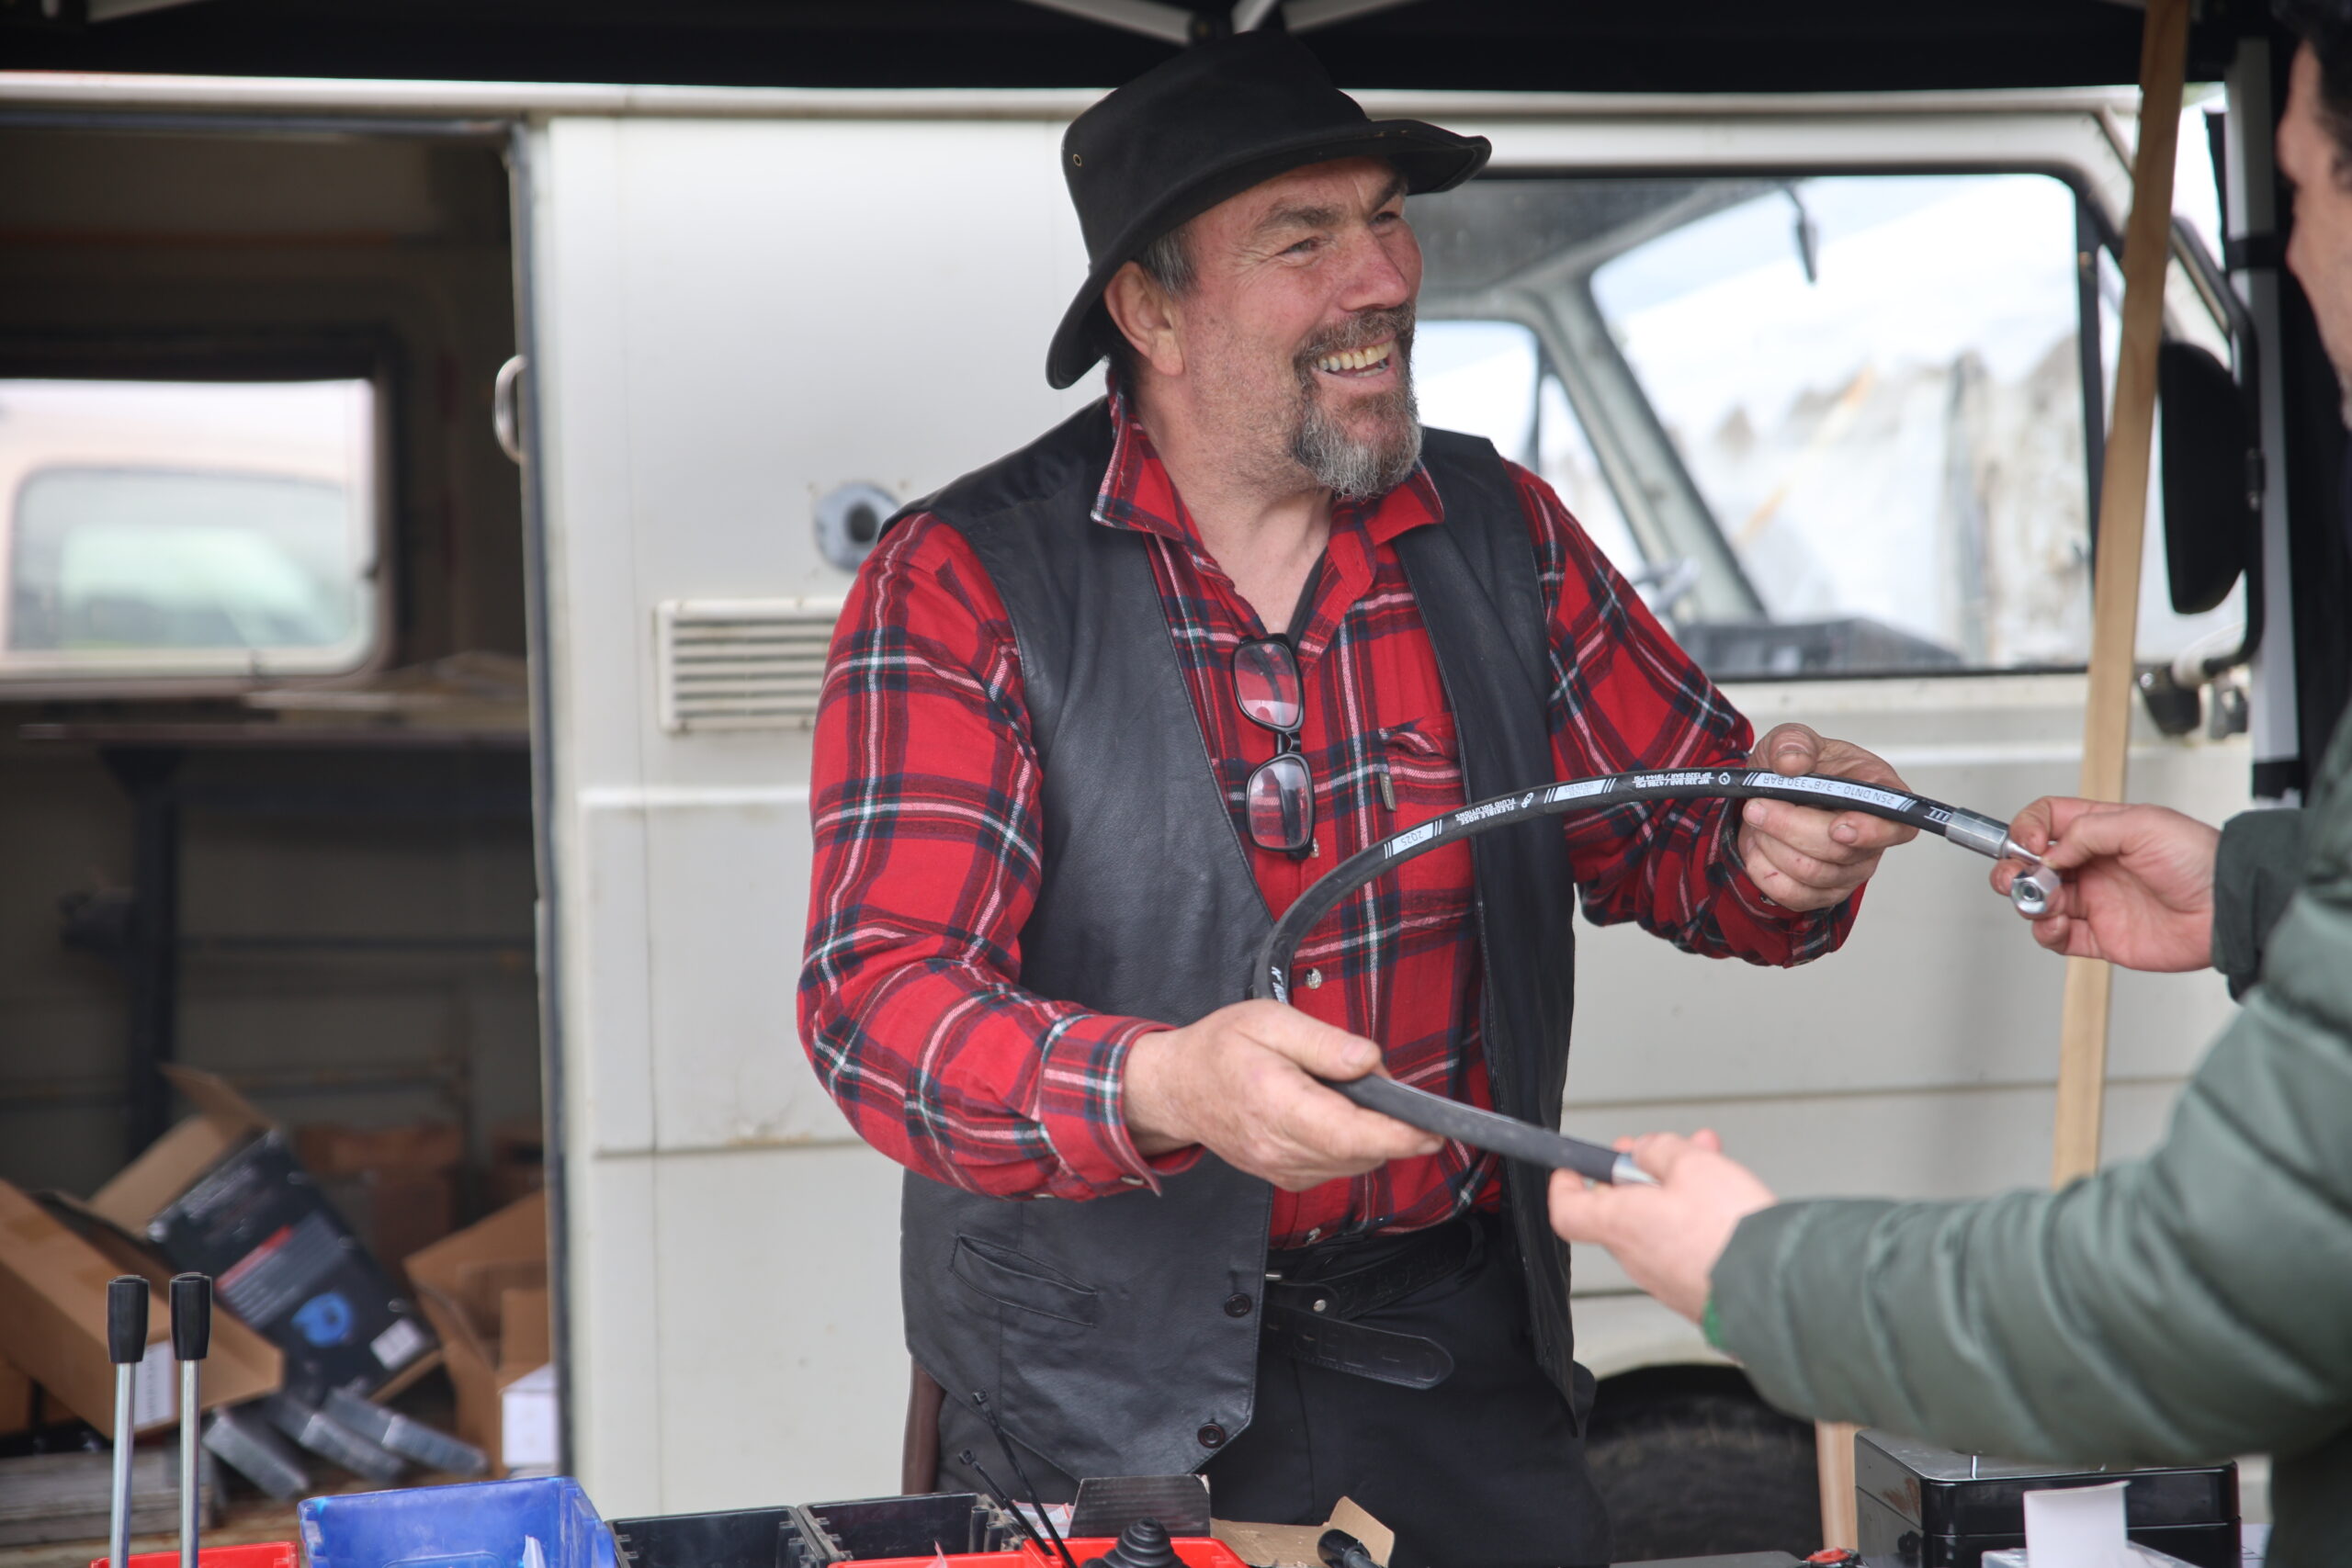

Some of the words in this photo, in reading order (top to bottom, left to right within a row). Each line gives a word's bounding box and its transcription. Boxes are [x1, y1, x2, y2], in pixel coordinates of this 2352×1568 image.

[1763, 774, 1784, 785] BAR
[1787, 777, 1808, 788] 330
[1844, 785, 1872, 799] DN10
[1494, 797, 1515, 808] FLUID
[1455, 803, 1493, 819] SOLUTIONS
[1481, 805, 1515, 819] FLEXIBLE
[1461, 814, 1479, 826] HOSE
